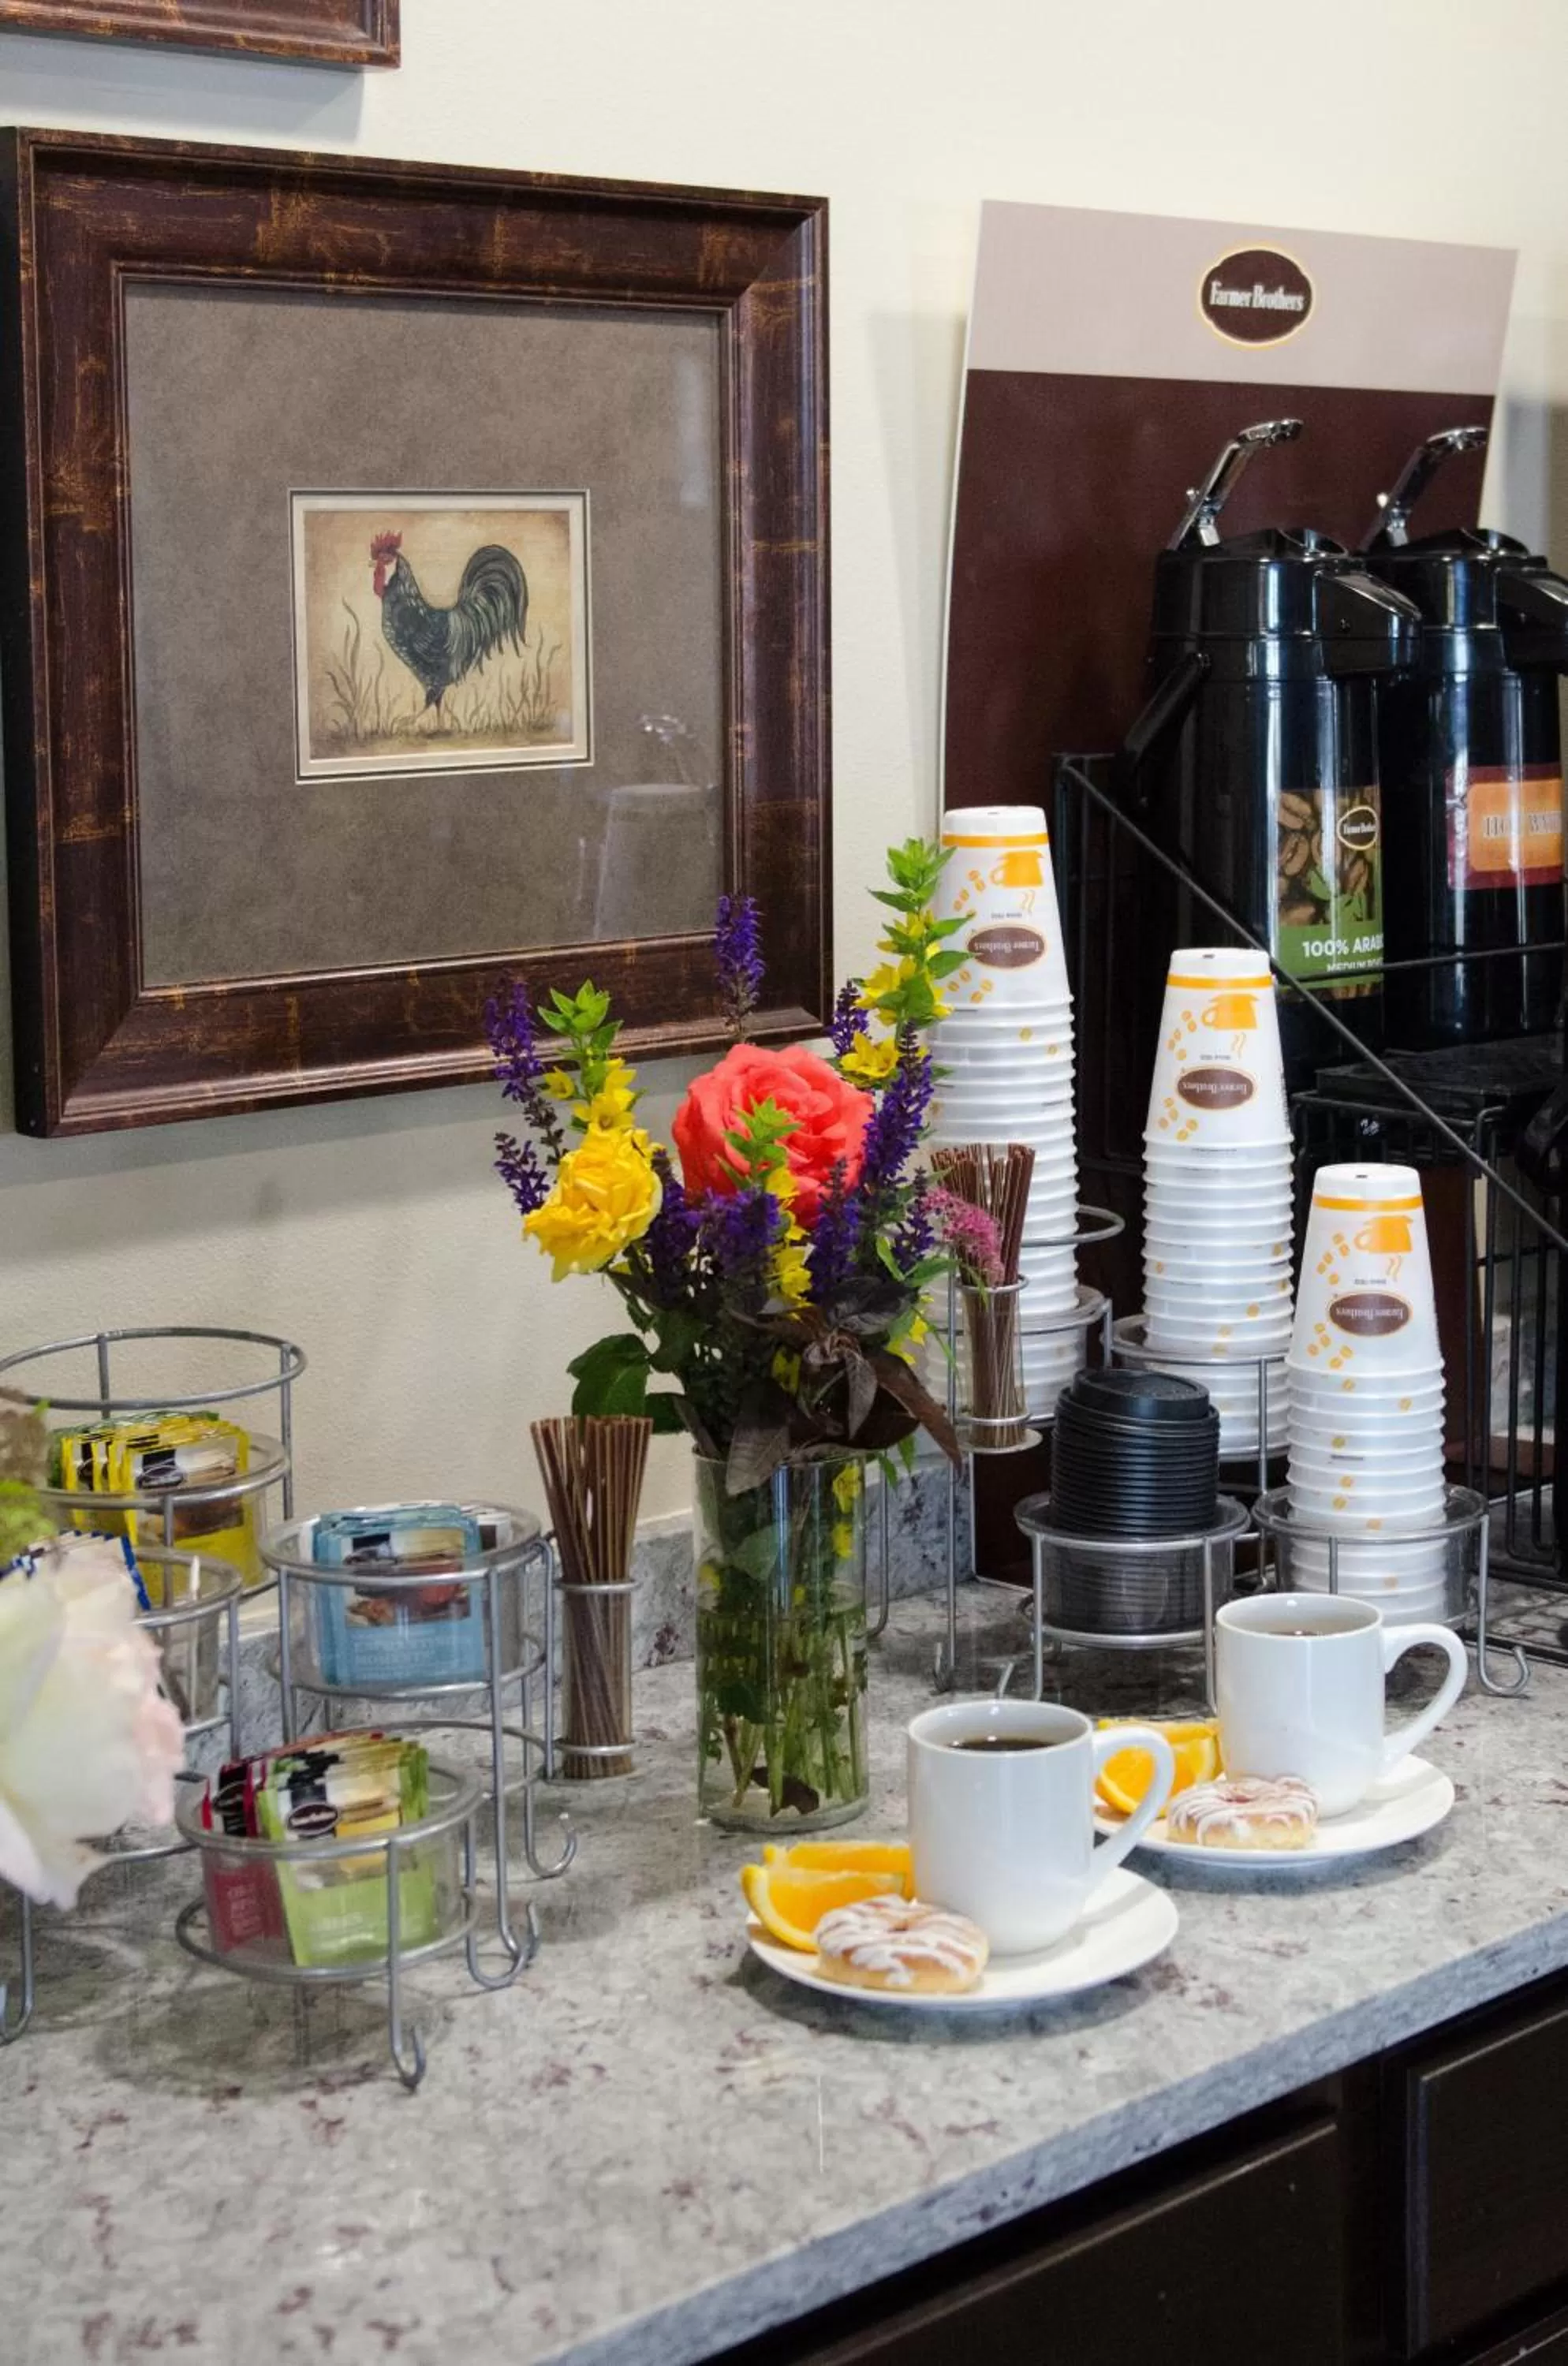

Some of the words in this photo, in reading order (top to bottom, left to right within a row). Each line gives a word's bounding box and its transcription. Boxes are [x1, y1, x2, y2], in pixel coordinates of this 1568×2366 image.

[1209, 280, 1252, 308] Farmer
[1253, 282, 1305, 312] Brothers
[1482, 814, 1523, 837] HO
[1302, 939, 1350, 958] 100%
